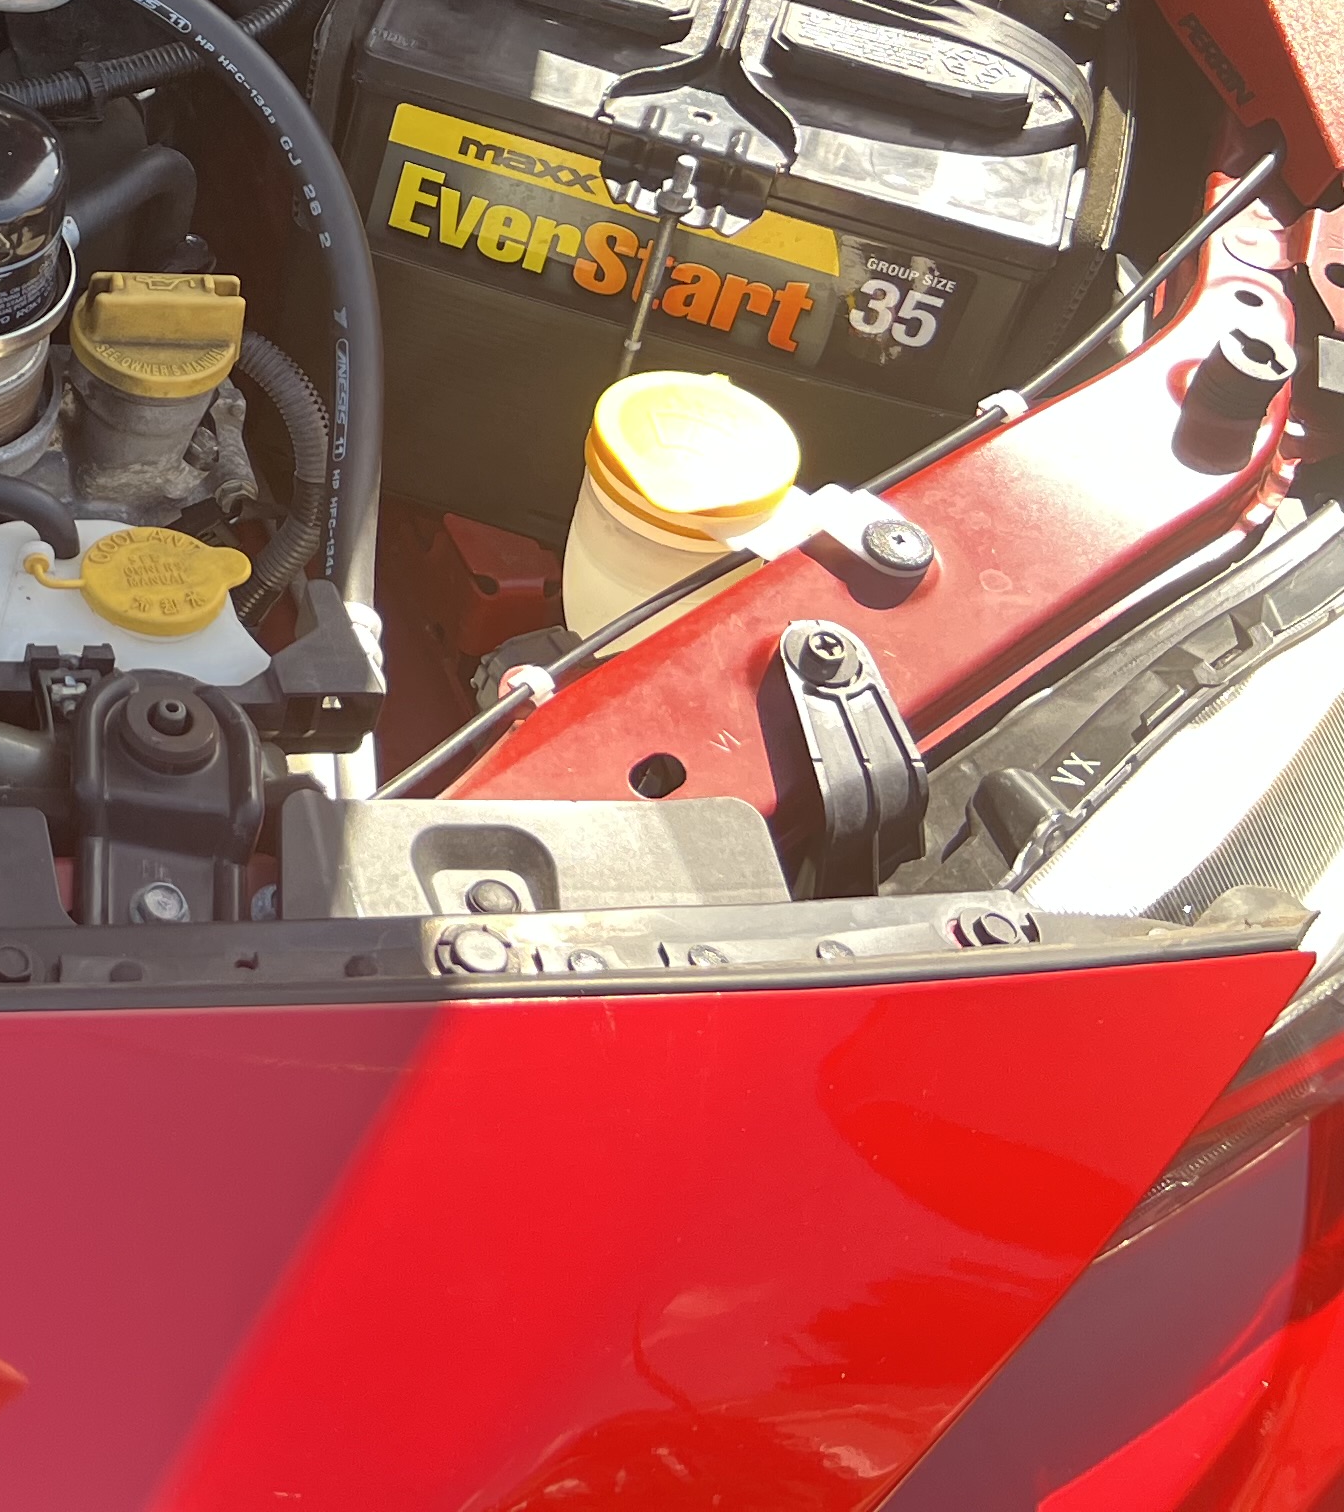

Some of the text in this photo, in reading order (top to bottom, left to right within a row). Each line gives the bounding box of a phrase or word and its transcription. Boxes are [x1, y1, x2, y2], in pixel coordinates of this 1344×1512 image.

[167, 12, 188, 30] 11
[195, 34, 216, 53] HP
[217, 54, 276, 125] HFC-134a
[459, 136, 601, 194] maxx
[866, 255, 957, 295] GROUP SIZE
[849, 278, 946, 349] 35
[96, 343, 229, 376] SEE OWNER'S MANUAL
[331, 468, 342, 491] HP
[89, 529, 202, 564] COOLANT
